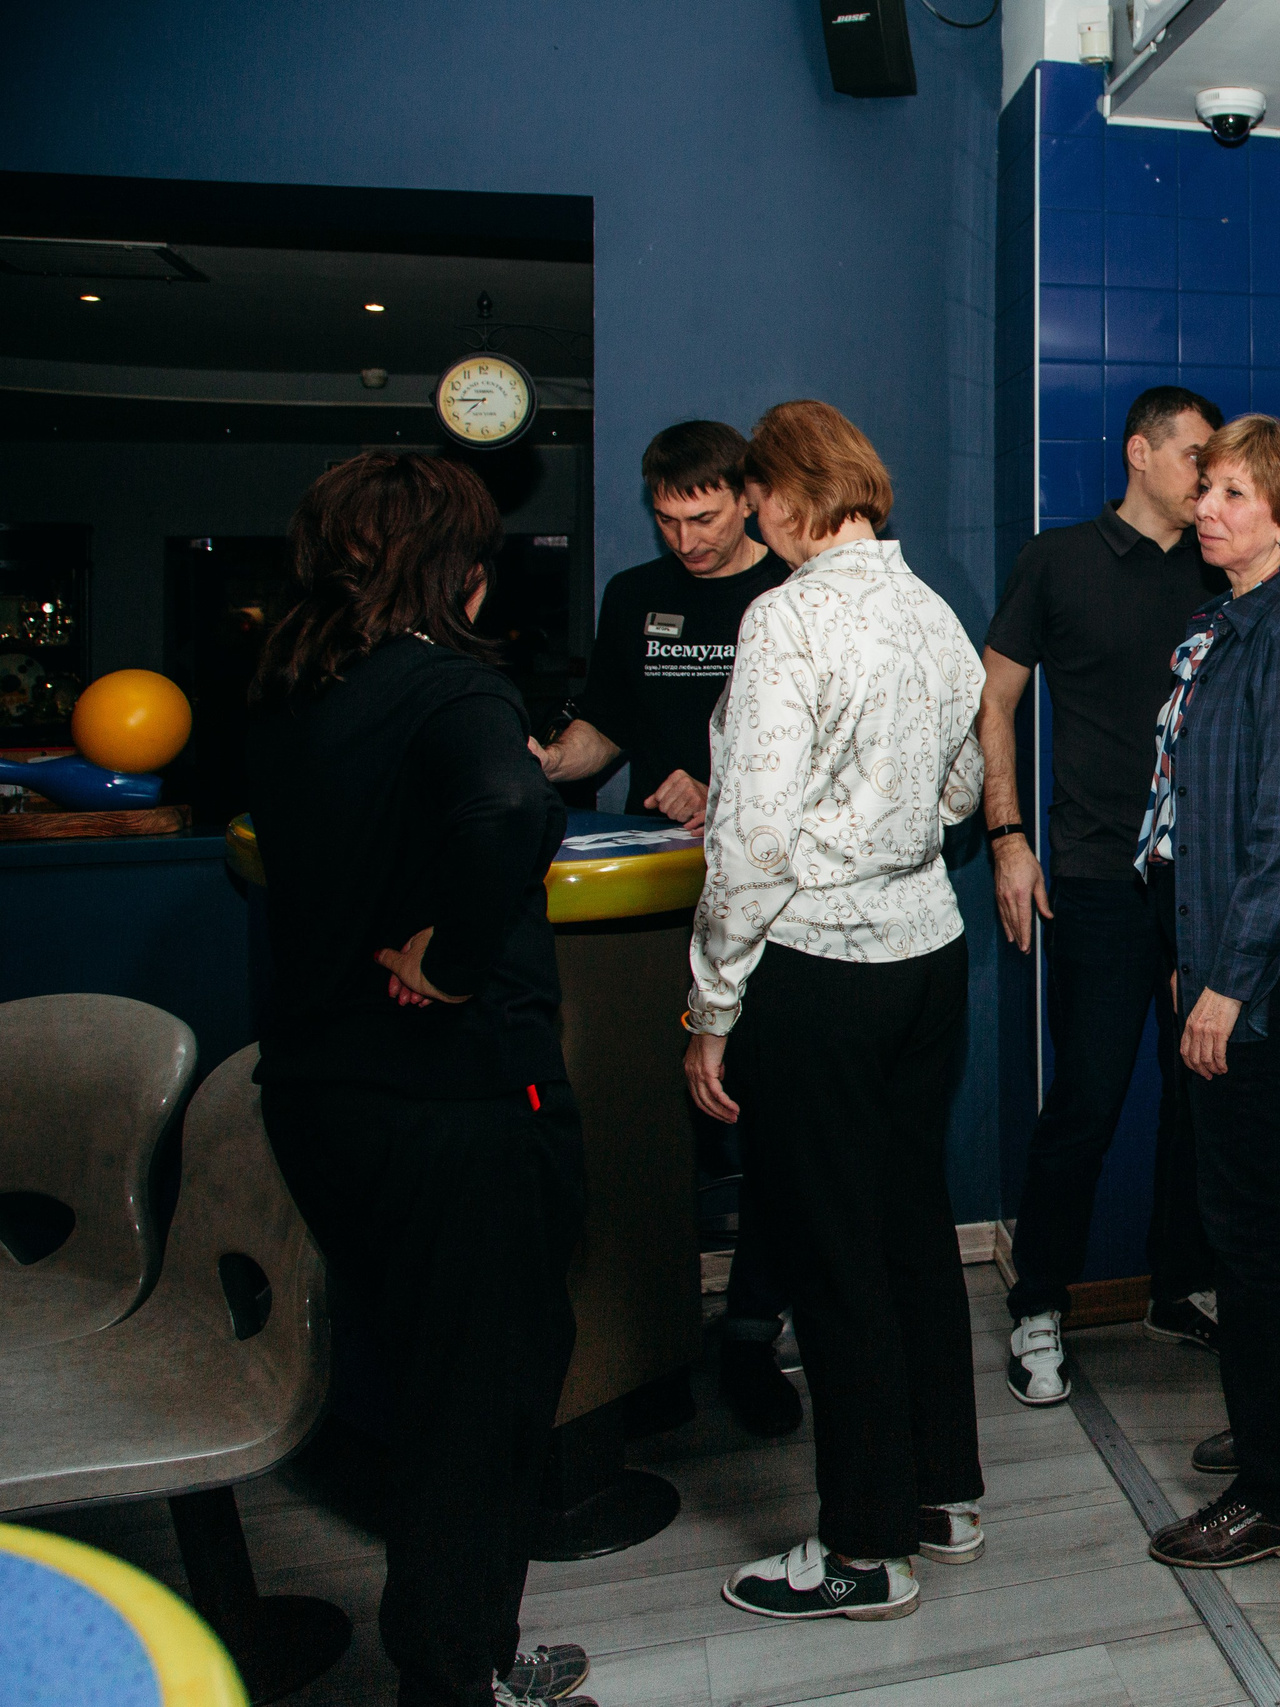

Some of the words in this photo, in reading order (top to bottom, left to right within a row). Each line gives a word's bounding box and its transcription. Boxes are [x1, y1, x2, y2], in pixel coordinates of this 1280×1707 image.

[832, 12, 871, 24] BOSE
[463, 370, 470, 379] 11
[479, 365, 489, 375] 12
[451, 380, 461, 391] 10
[460, 381, 479, 400] GRAND
[481, 380, 508, 398] CENTRAL
[509, 380, 517, 390] 2
[446, 396, 455, 407] 9
[514, 394, 522, 405] 3
[452, 412, 460, 420] 8
[465, 422, 471, 433] 7
[481, 426, 489, 436] 6
[500, 421, 506, 432] 5
[645, 640, 738, 662] Всемуда
